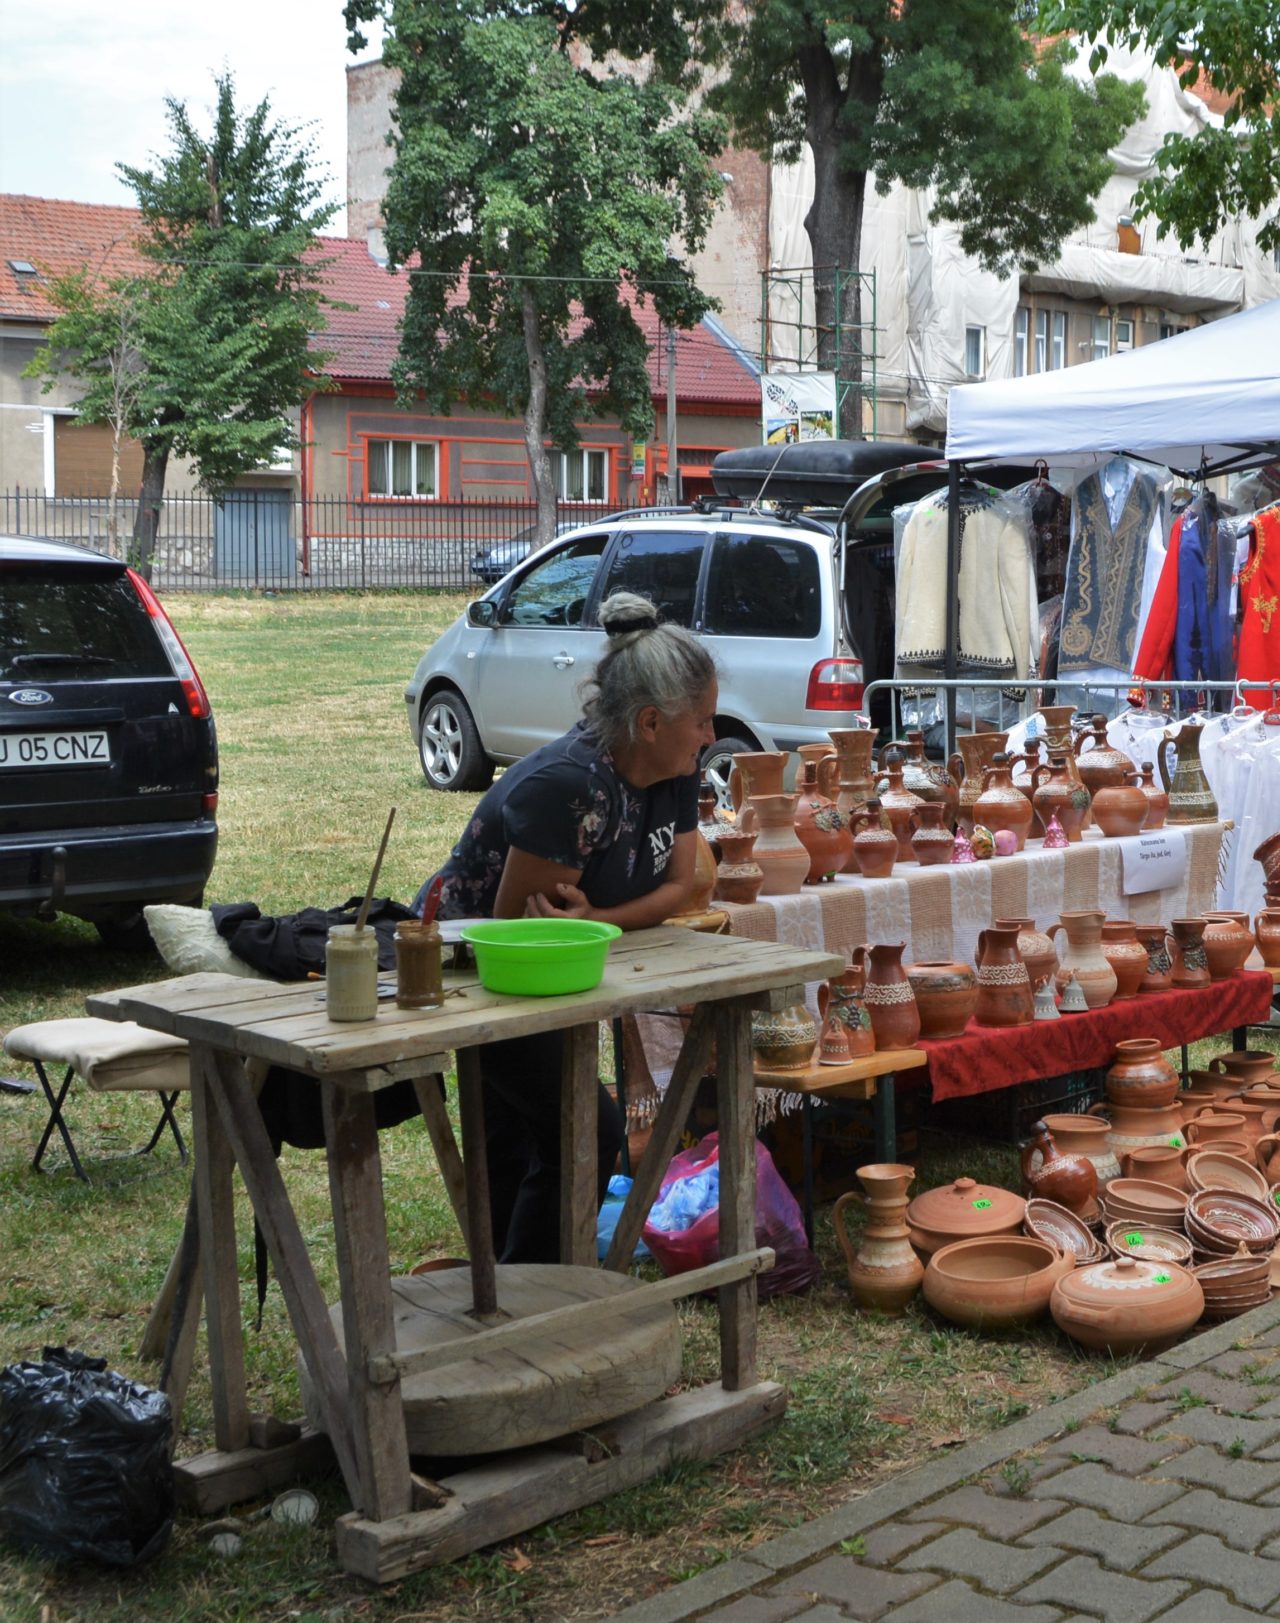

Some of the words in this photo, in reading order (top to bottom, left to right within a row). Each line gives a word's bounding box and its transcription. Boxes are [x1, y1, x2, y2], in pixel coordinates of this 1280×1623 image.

[18, 737, 49, 762] 05
[53, 734, 107, 760] CNZ
[647, 821, 676, 856] NY
